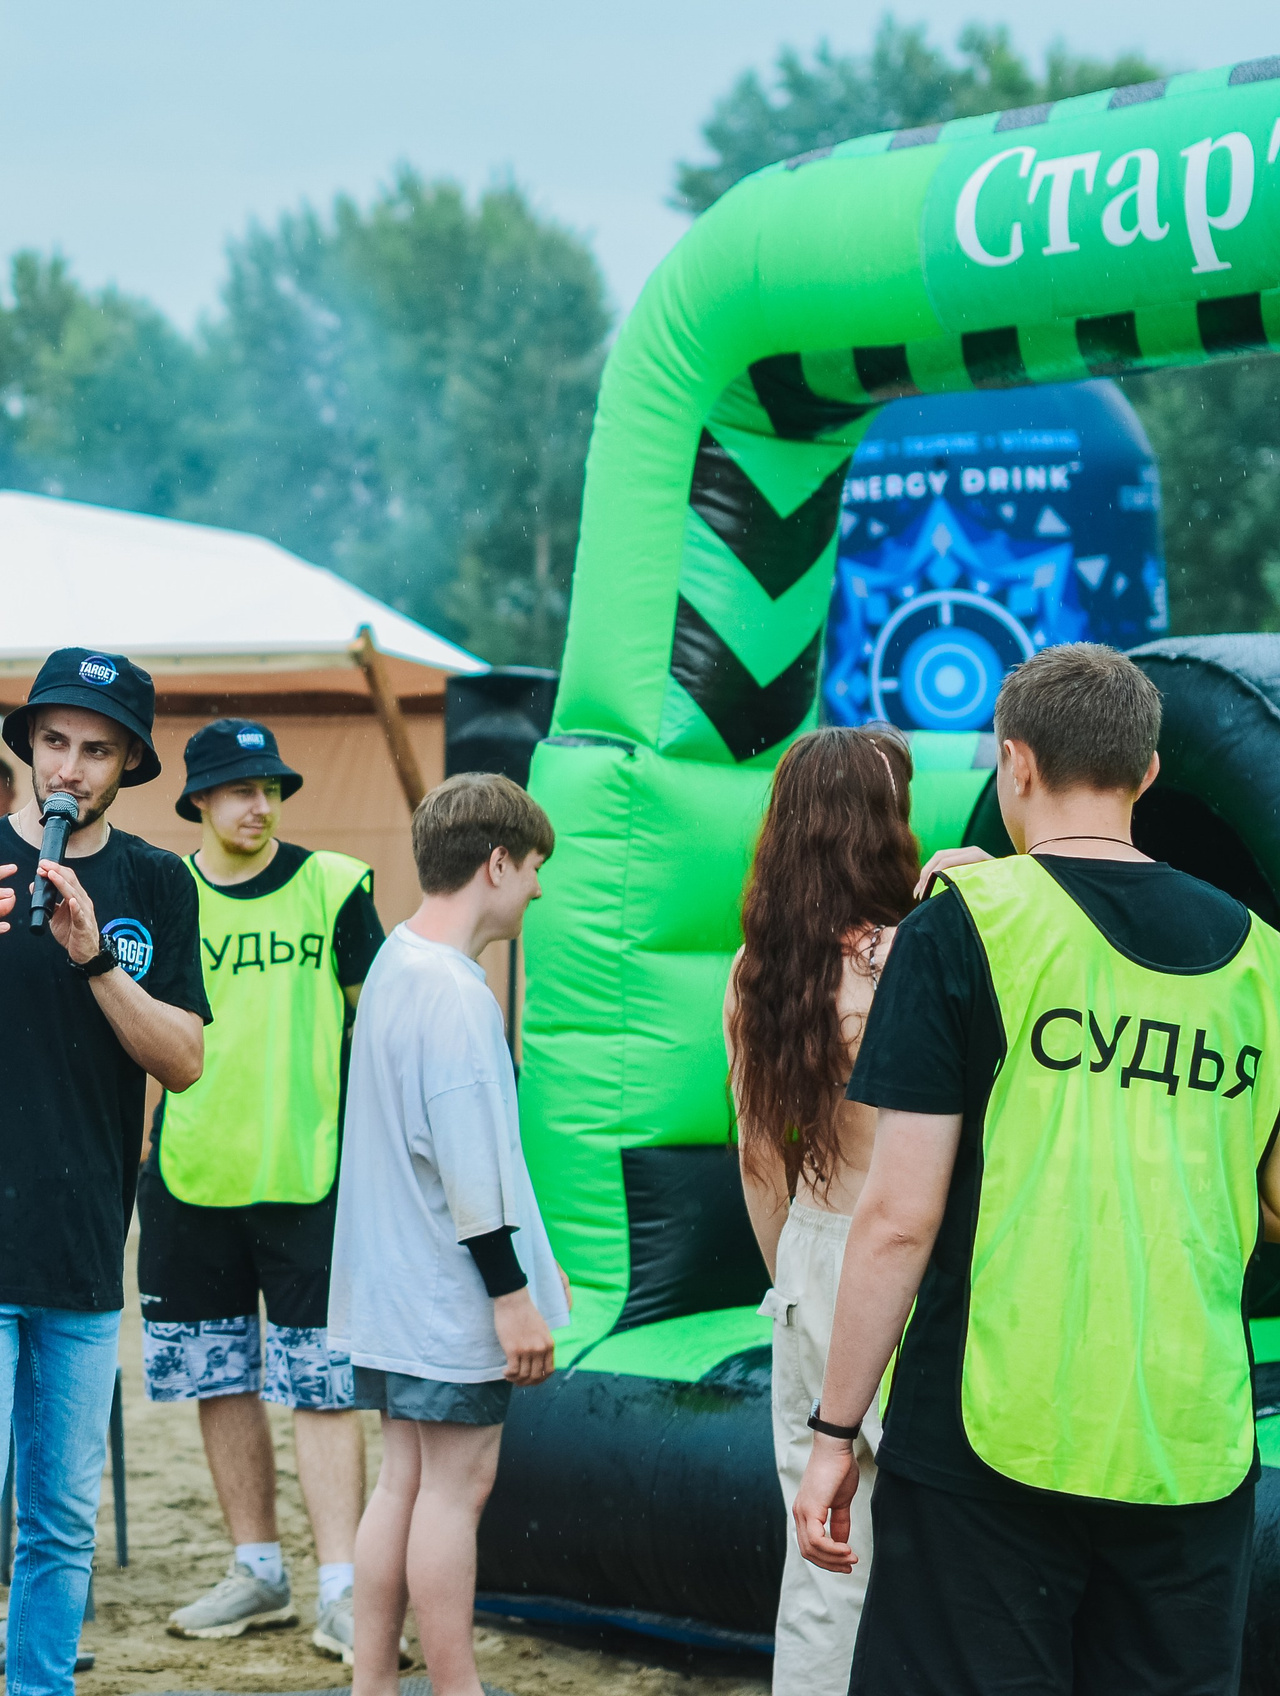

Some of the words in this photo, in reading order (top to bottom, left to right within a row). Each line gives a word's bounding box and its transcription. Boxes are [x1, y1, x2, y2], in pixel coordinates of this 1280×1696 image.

[954, 116, 1280, 275] Стар
[960, 464, 1071, 495] DRINK
[80, 661, 117, 681] TARGET
[117, 937, 153, 967] RGET
[200, 930, 325, 976] УДЬЯ
[1030, 1007, 1263, 1100] СУДЬЯ
